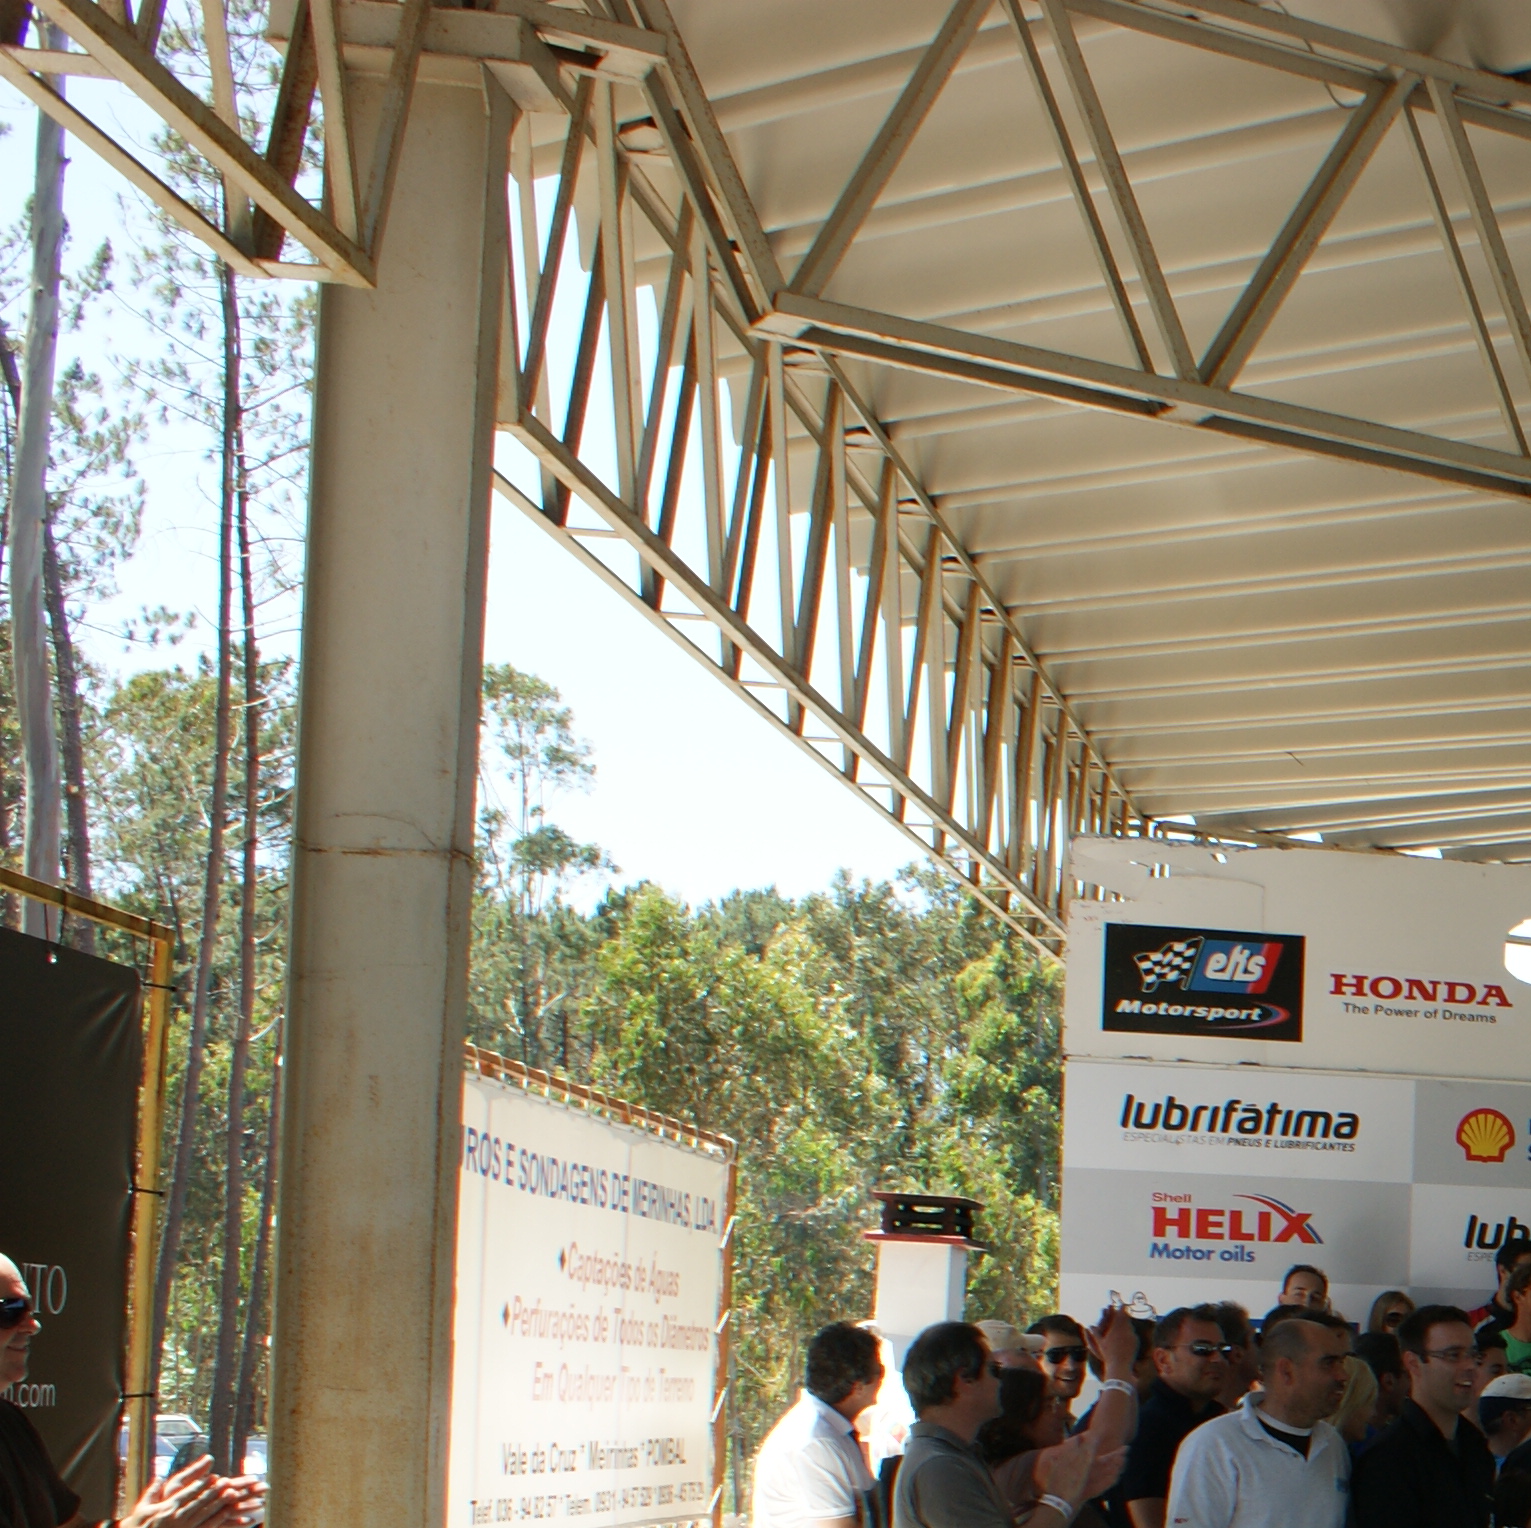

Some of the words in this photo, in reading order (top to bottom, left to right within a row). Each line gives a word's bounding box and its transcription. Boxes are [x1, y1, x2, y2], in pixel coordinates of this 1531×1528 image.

[1329, 974, 1513, 1008] HONDA
[1115, 999, 1262, 1021] Motorsport
[1344, 1002, 1369, 1015] The
[1374, 1004, 1420, 1018] Power
[1424, 1008, 1438, 1019] of
[1443, 1009, 1496, 1023] Dreams
[1123, 1132, 1206, 1146] ESPECIALISTAS
[1208, 1136, 1226, 1146] EM
[1227, 1137, 1262, 1148] PNEUS
[1264, 1139, 1272, 1148] E
[1273, 1140, 1356, 1152] LUBRIFICANTES
[504, 1142, 516, 1186] E
[518, 1148, 608, 1209] SONDAGENS
[610, 1172, 630, 1213] DE
[1152, 1192, 1191, 1203] Shell
[1151, 1207, 1320, 1244] HELIX
[1150, 1243, 1215, 1260] Motor
[1219, 1245, 1255, 1262] oils
